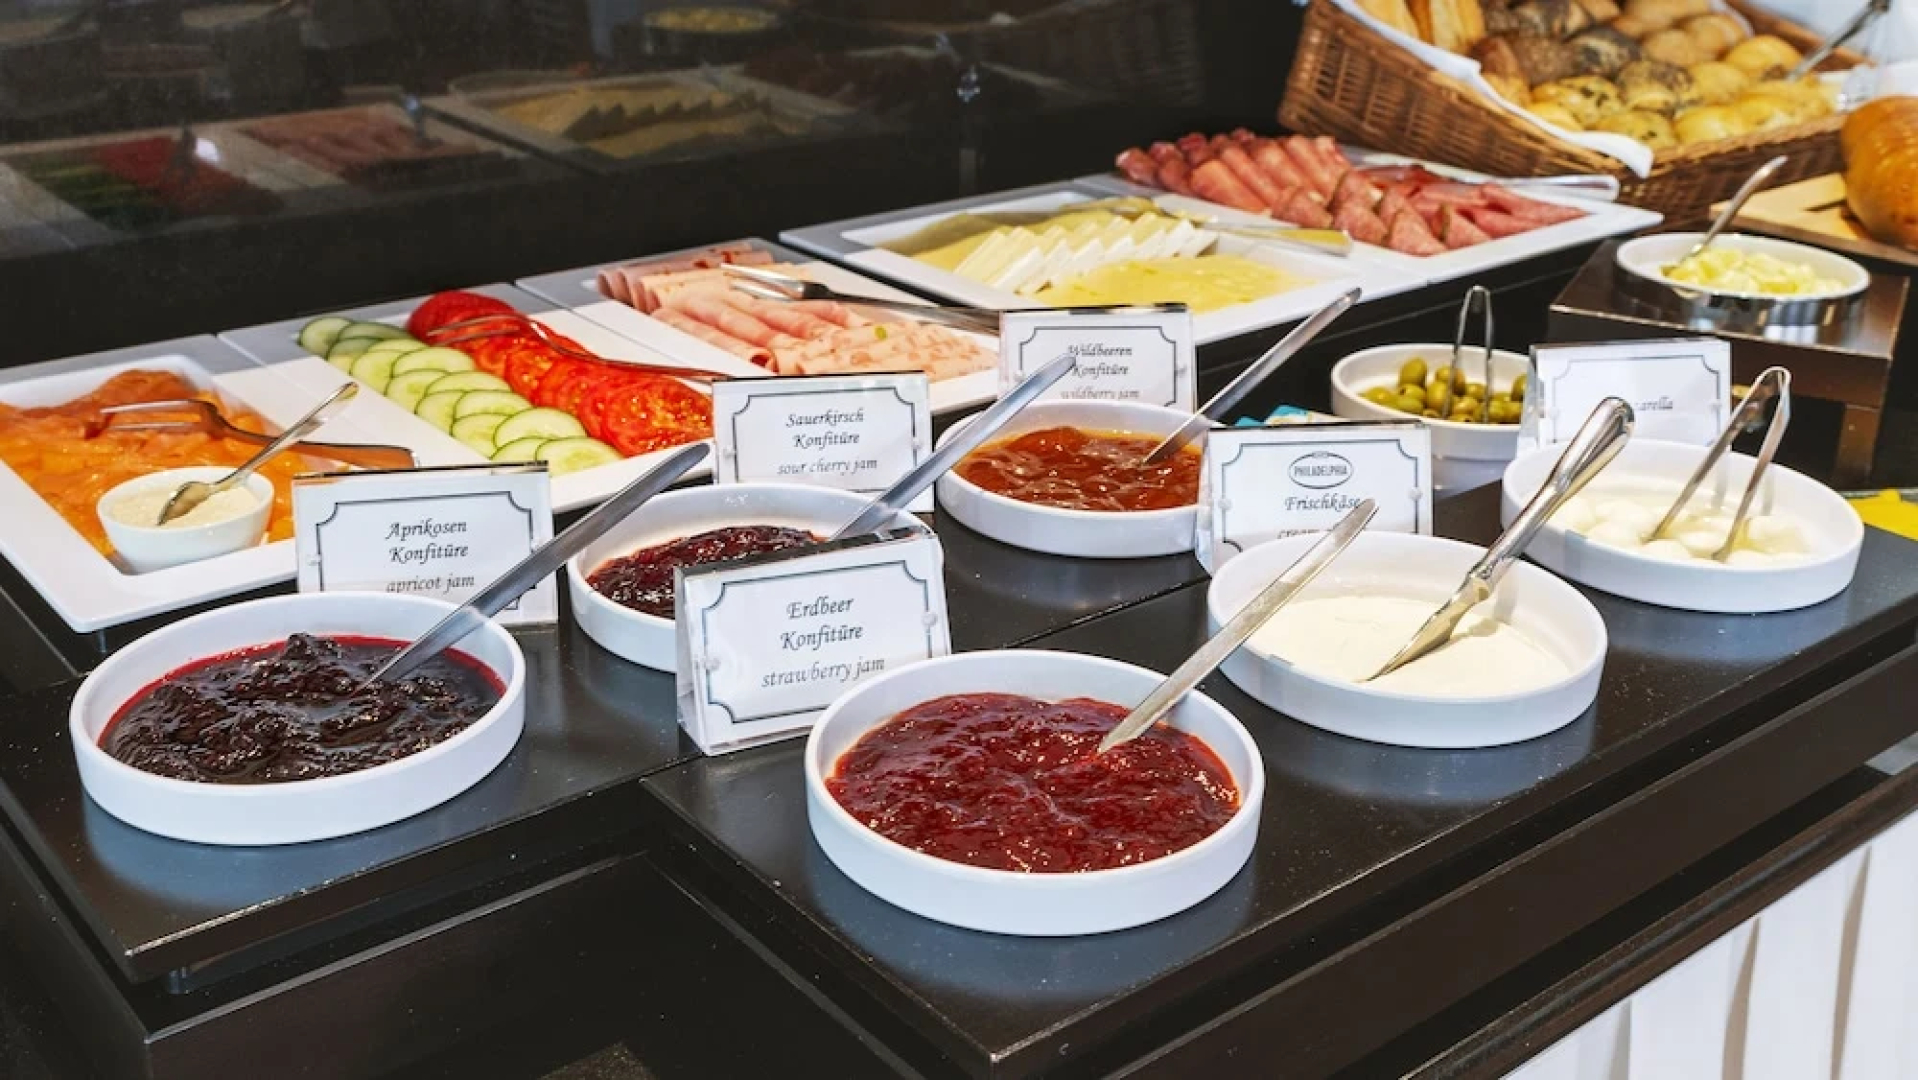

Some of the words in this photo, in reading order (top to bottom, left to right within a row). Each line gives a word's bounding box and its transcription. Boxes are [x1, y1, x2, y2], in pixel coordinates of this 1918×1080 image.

[1067, 343, 1132, 357] Wildbeeren
[1072, 362, 1129, 380] Konfitüre
[785, 407, 864, 428] Sauerkirsch
[792, 430, 859, 450] Konfitüre
[776, 463, 806, 475] sour
[809, 457, 849, 476] cherry
[850, 456, 877, 475] jam
[1294, 465, 1347, 476] PHILADELPHIA
[385, 517, 467, 540] Aprikosen
[388, 542, 469, 566] Konfitüre
[386, 575, 441, 594] apricot
[442, 572, 475, 595] jam
[786, 595, 854, 620] Erdbeer
[780, 624, 864, 650] Konfitüre
[761, 662, 852, 688] strawberry
[852, 656, 885, 681] jam
